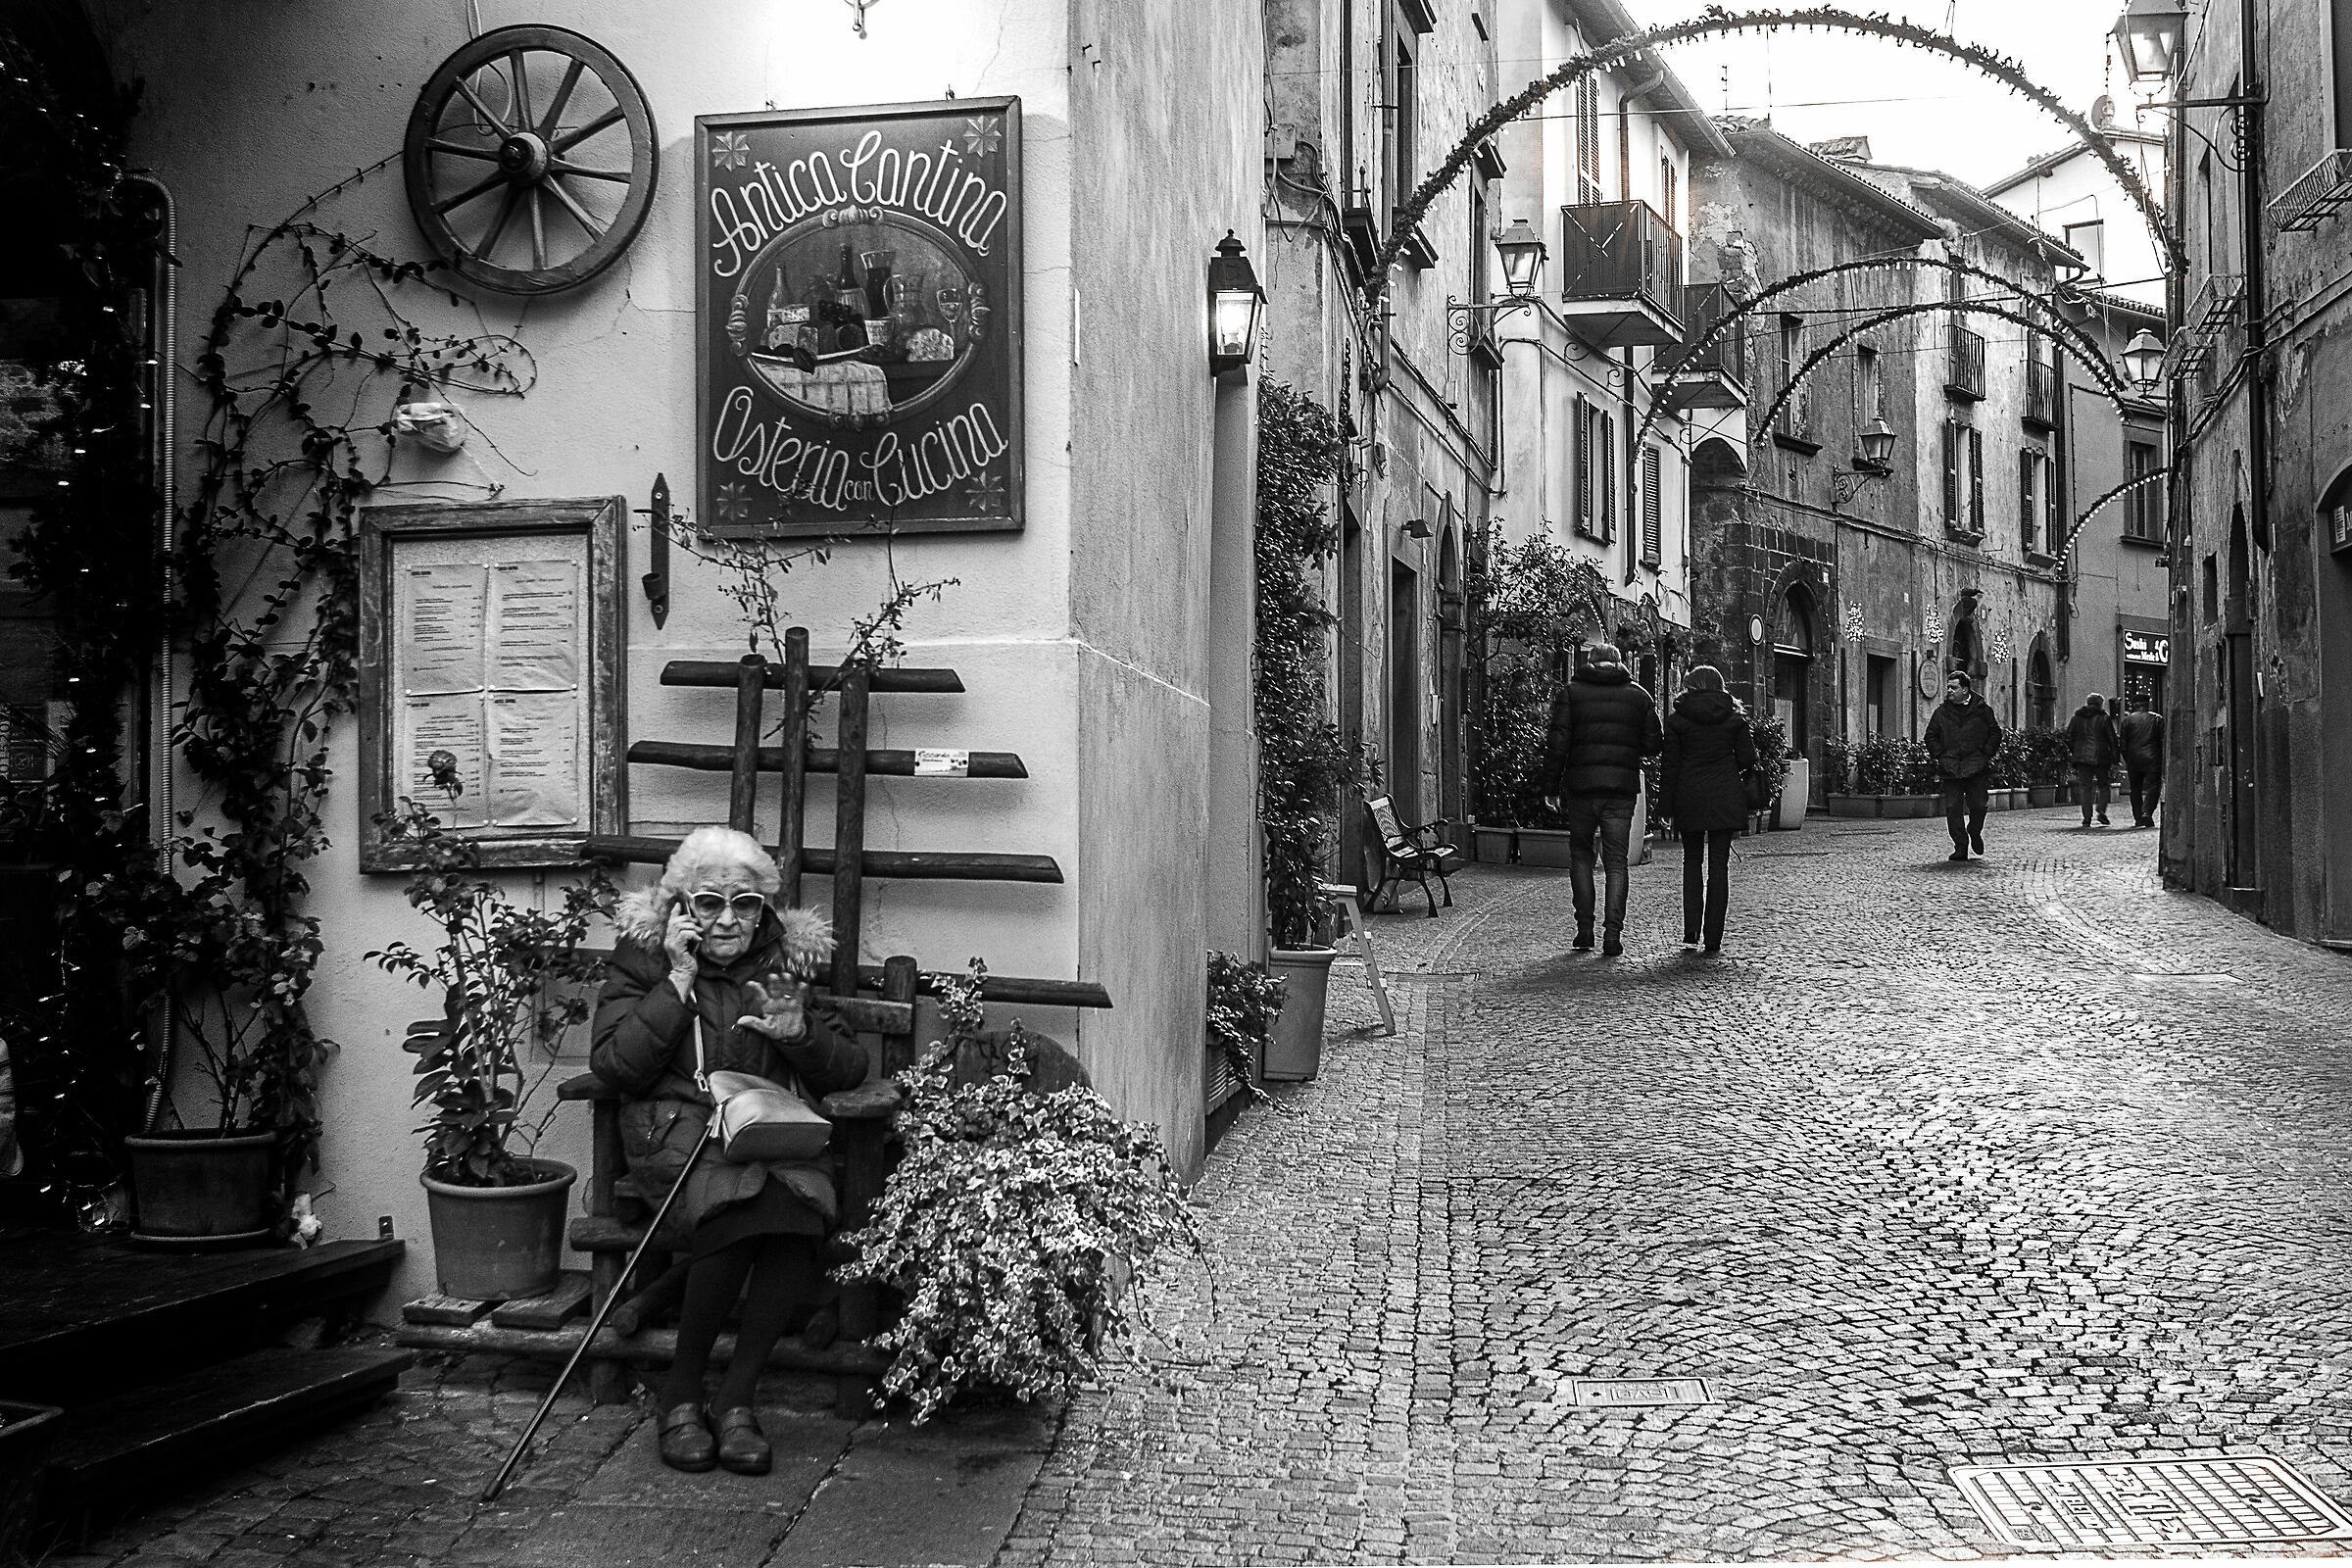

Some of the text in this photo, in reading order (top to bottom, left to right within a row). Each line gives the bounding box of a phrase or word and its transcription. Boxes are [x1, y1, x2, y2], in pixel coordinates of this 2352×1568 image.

[711, 130, 1007, 277] Antica Cantina
[713, 385, 1008, 511] Osteria con Cucina
